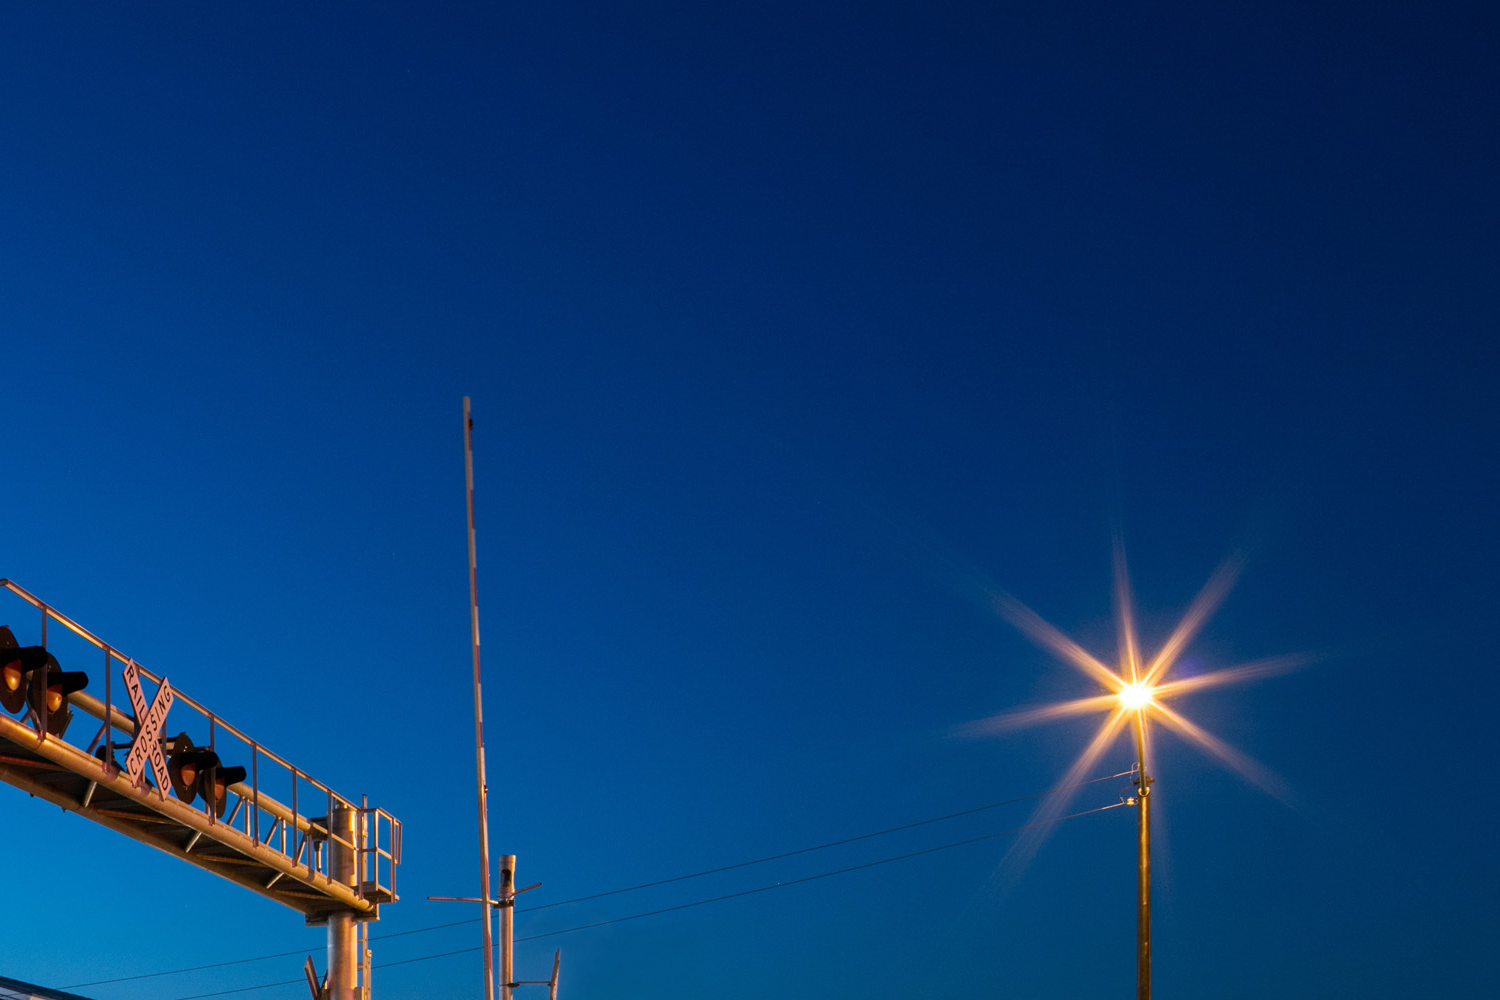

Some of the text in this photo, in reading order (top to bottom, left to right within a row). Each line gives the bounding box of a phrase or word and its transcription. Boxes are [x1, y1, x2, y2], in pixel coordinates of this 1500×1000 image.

[126, 665, 169, 791] RAIL ROAD
[129, 685, 171, 776] CROSSING
